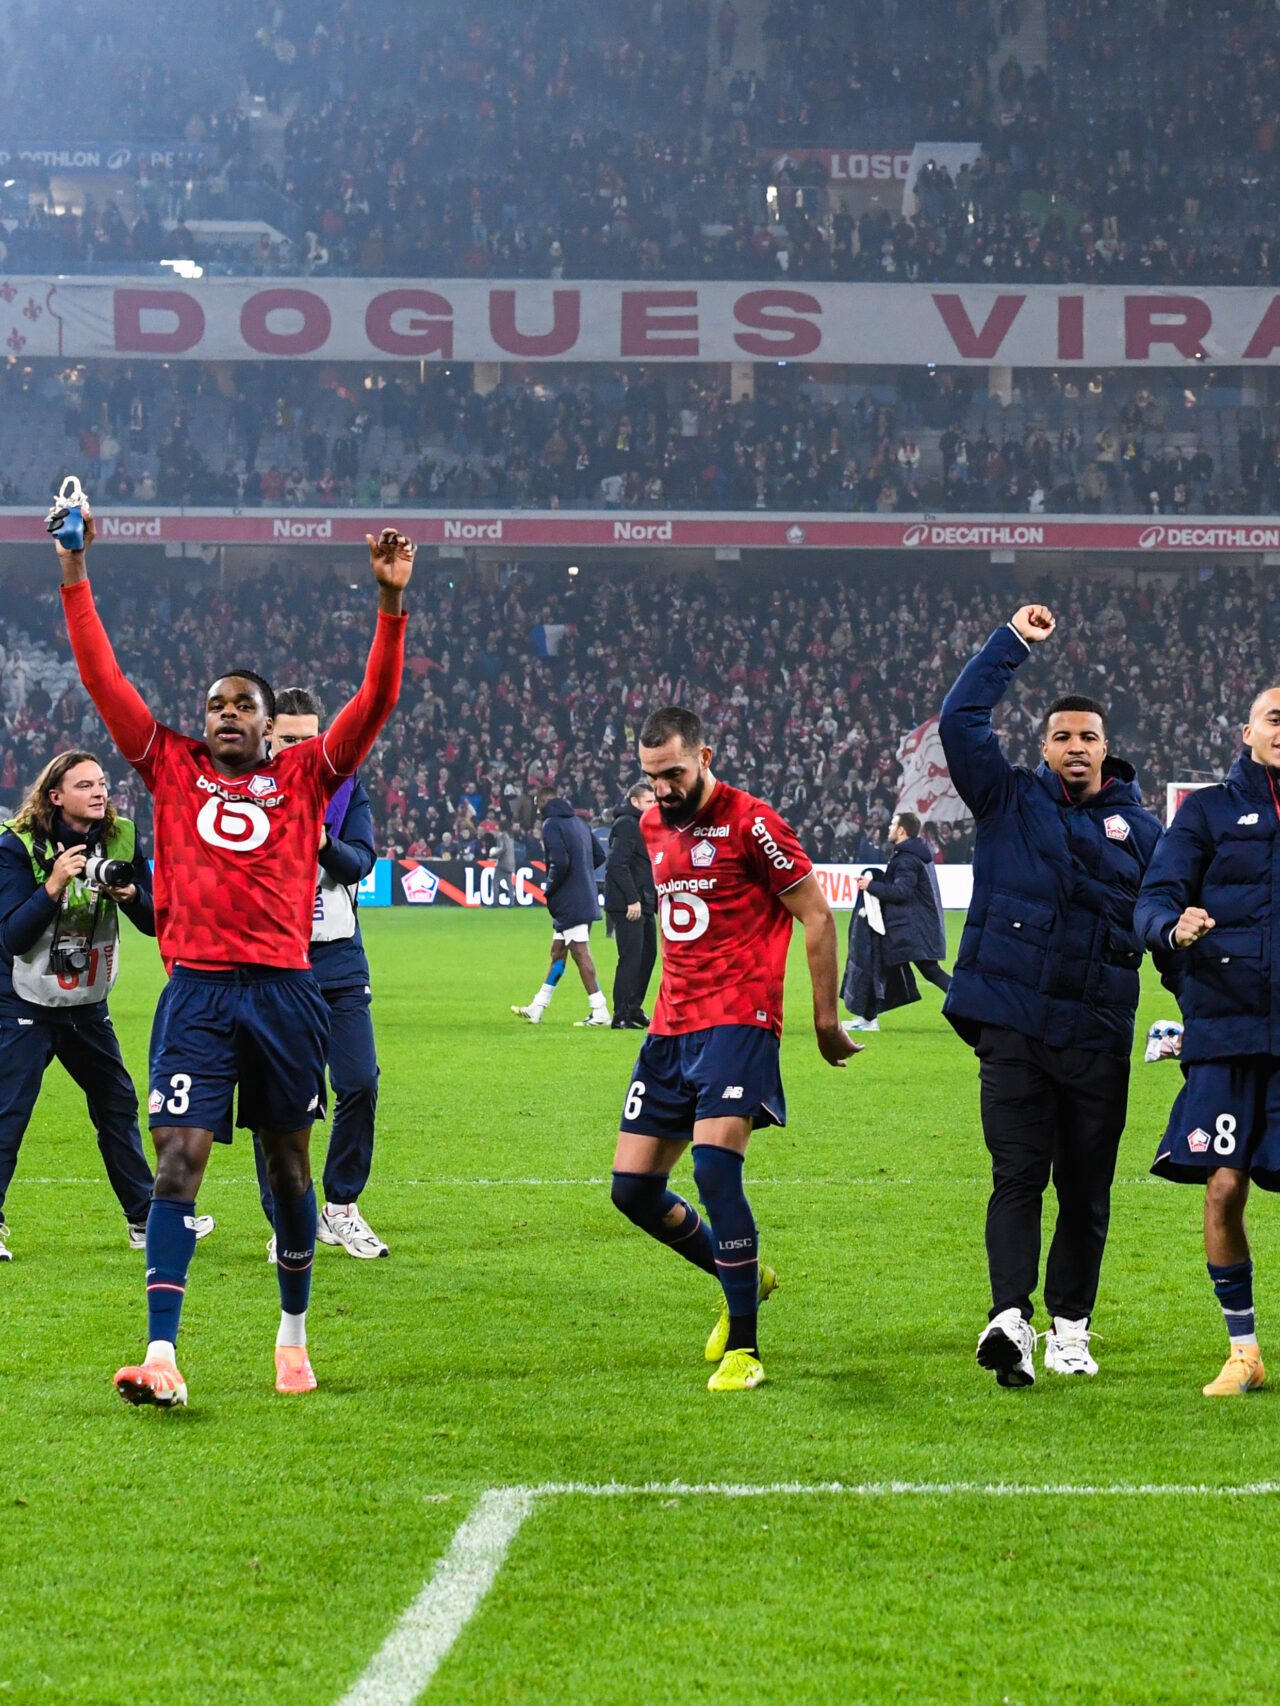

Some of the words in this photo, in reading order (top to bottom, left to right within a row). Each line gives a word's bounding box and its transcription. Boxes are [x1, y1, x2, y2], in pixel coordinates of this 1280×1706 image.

[113, 288, 823, 360] DOGUES
[102, 517, 161, 537] Nord
[273, 519, 331, 538] Nord
[444, 520, 503, 539] Nord
[614, 521, 672, 540] Nord
[931, 527, 1043, 545] DECATHLON
[1167, 529, 1280, 546] DECATHLON
[693, 824, 731, 838] actual
[167, 1073, 192, 1115] 3
[624, 1080, 646, 1120] 6
[1213, 1113, 1237, 1156] 8
[719, 1238, 753, 1251] LOSC
[282, 1249, 312, 1260] LOSC
